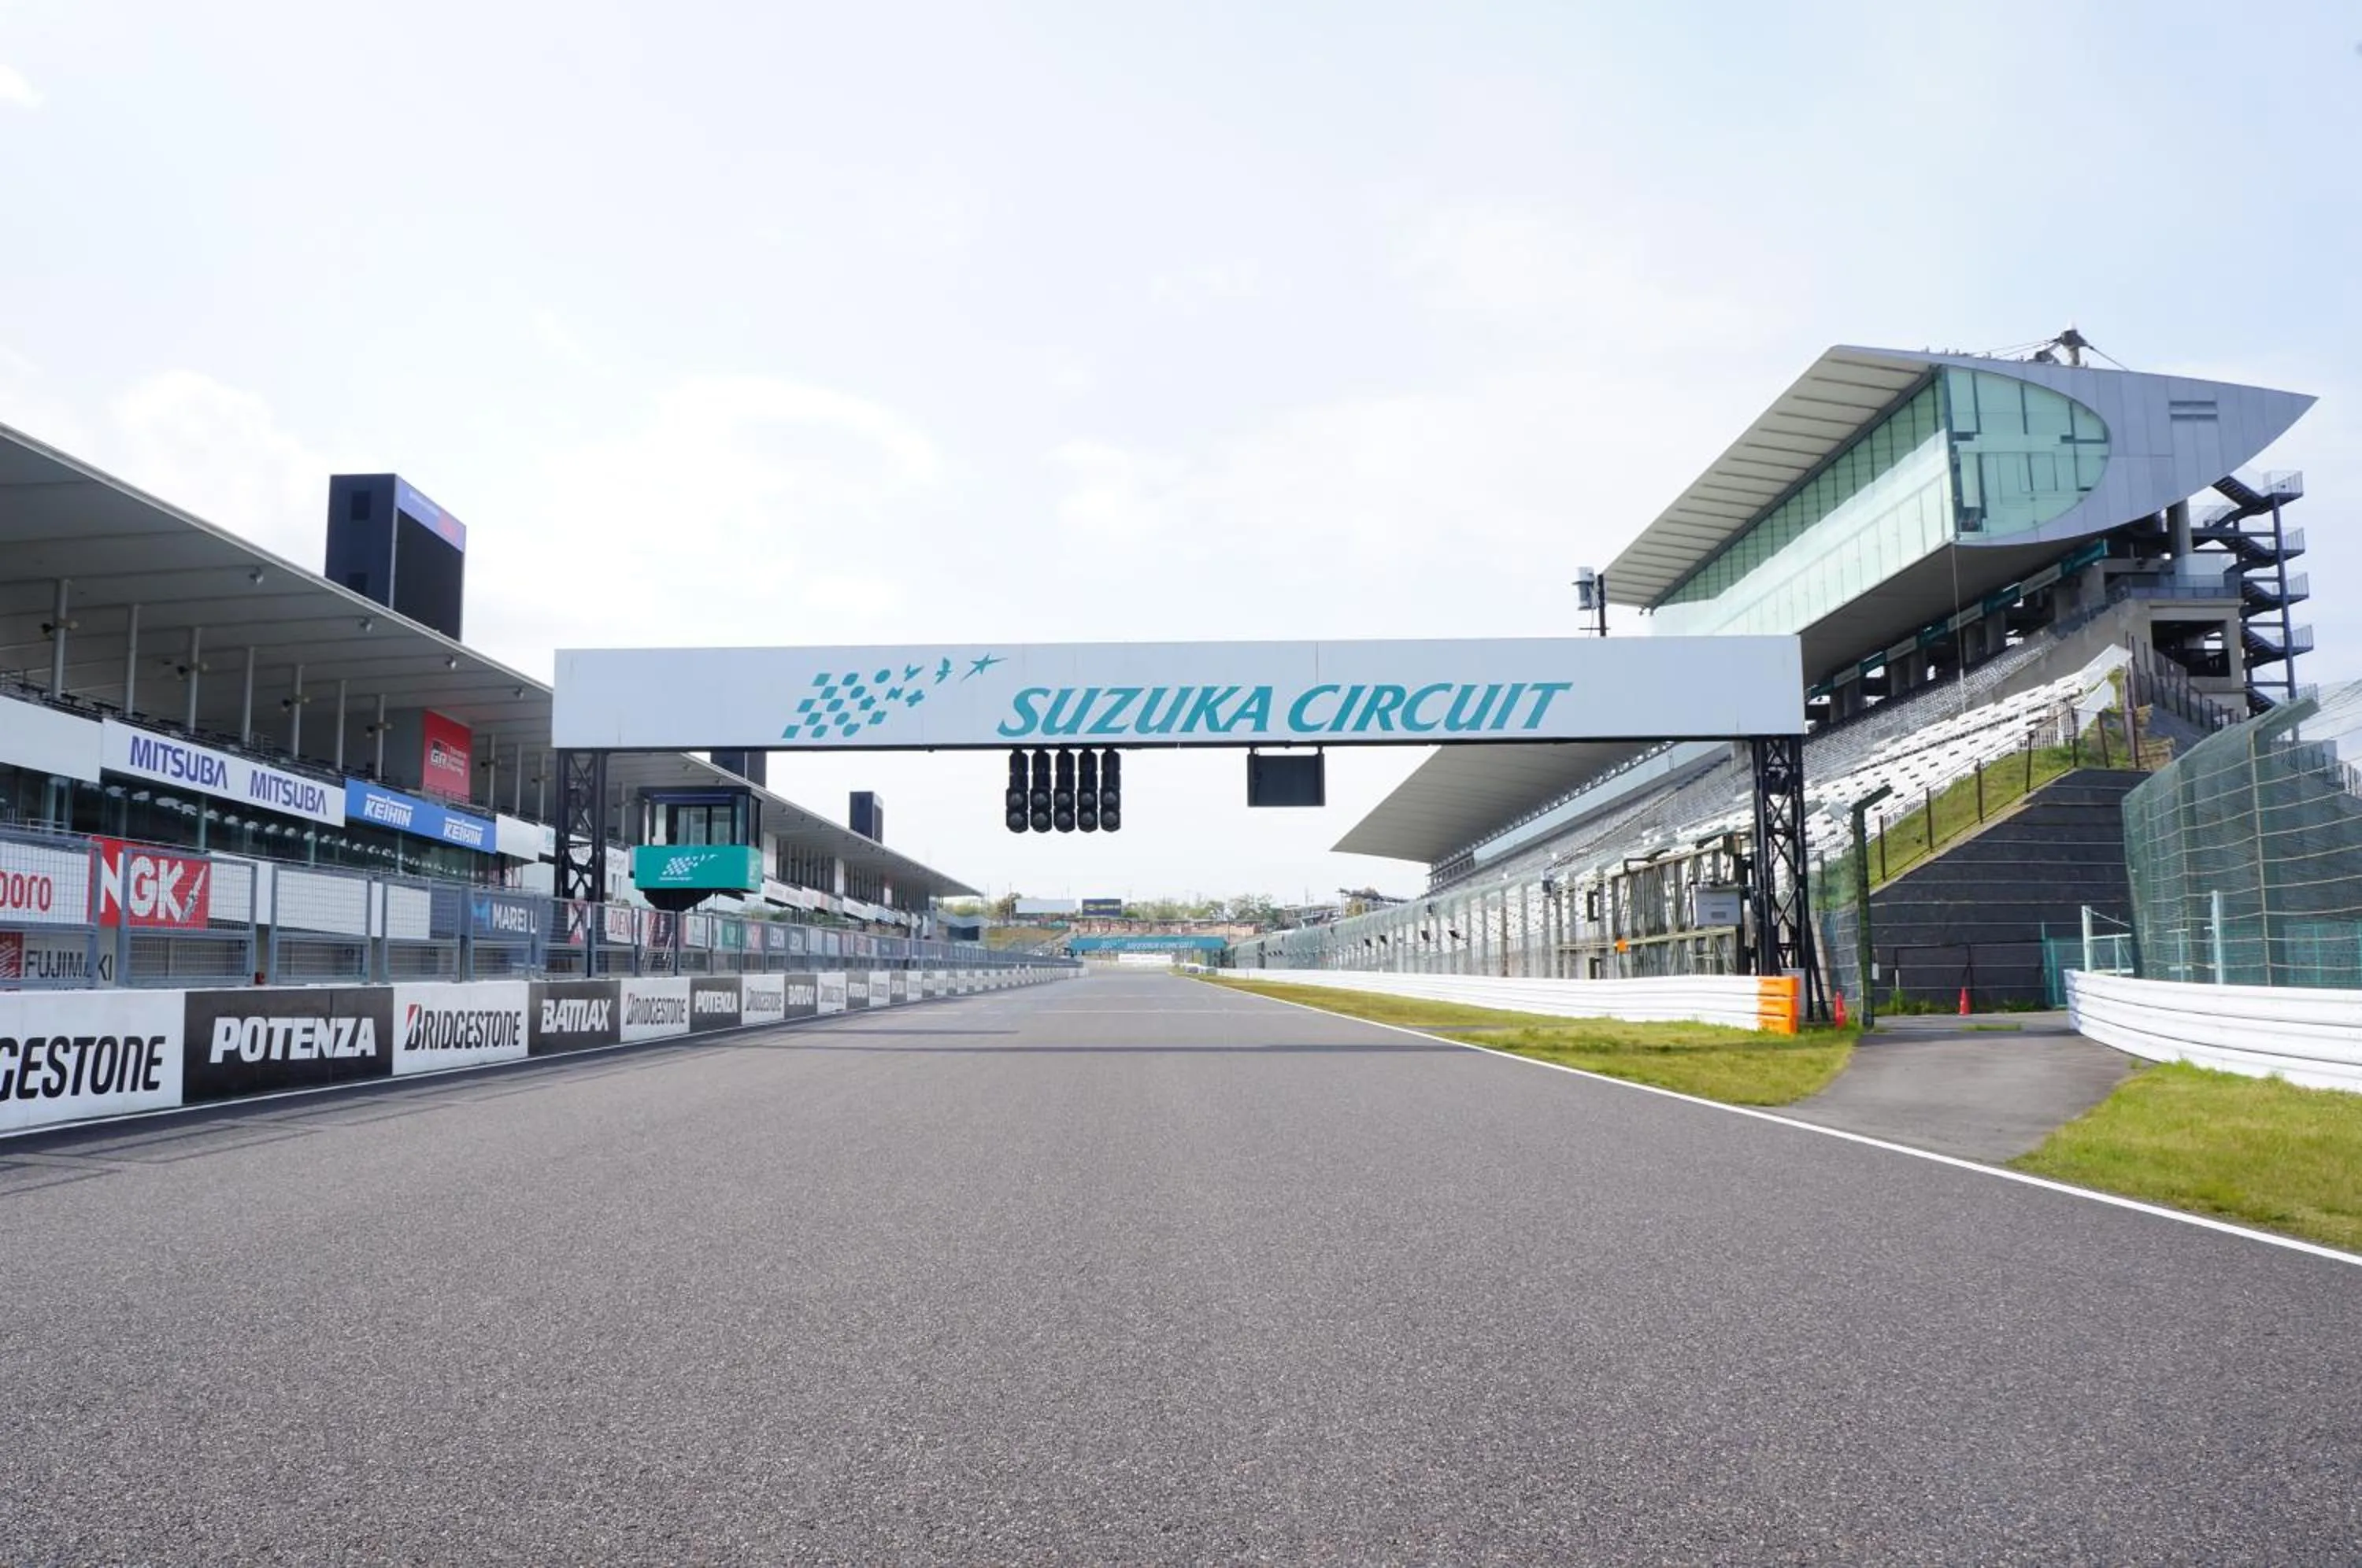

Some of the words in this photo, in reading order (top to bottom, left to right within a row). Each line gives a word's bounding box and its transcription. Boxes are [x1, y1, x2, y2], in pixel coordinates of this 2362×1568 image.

[997, 686, 1272, 738] SUZUKA
[1287, 682, 1573, 734] CIRCUIT
[130, 735, 228, 790] MITSUBA
[250, 770, 327, 815] MITSUBA
[364, 793, 413, 827] KEIHIN
[443, 816, 484, 846] KEIHIN
[100, 852, 185, 923] NGK
[540, 999, 611, 1034] BATTLAX
[626, 993, 687, 1026] BRIDGESTONE
[695, 990, 738, 1013] POTENZA
[209, 1016, 376, 1063] POTENZA
[404, 1004, 521, 1050] BRIDGESTONE
